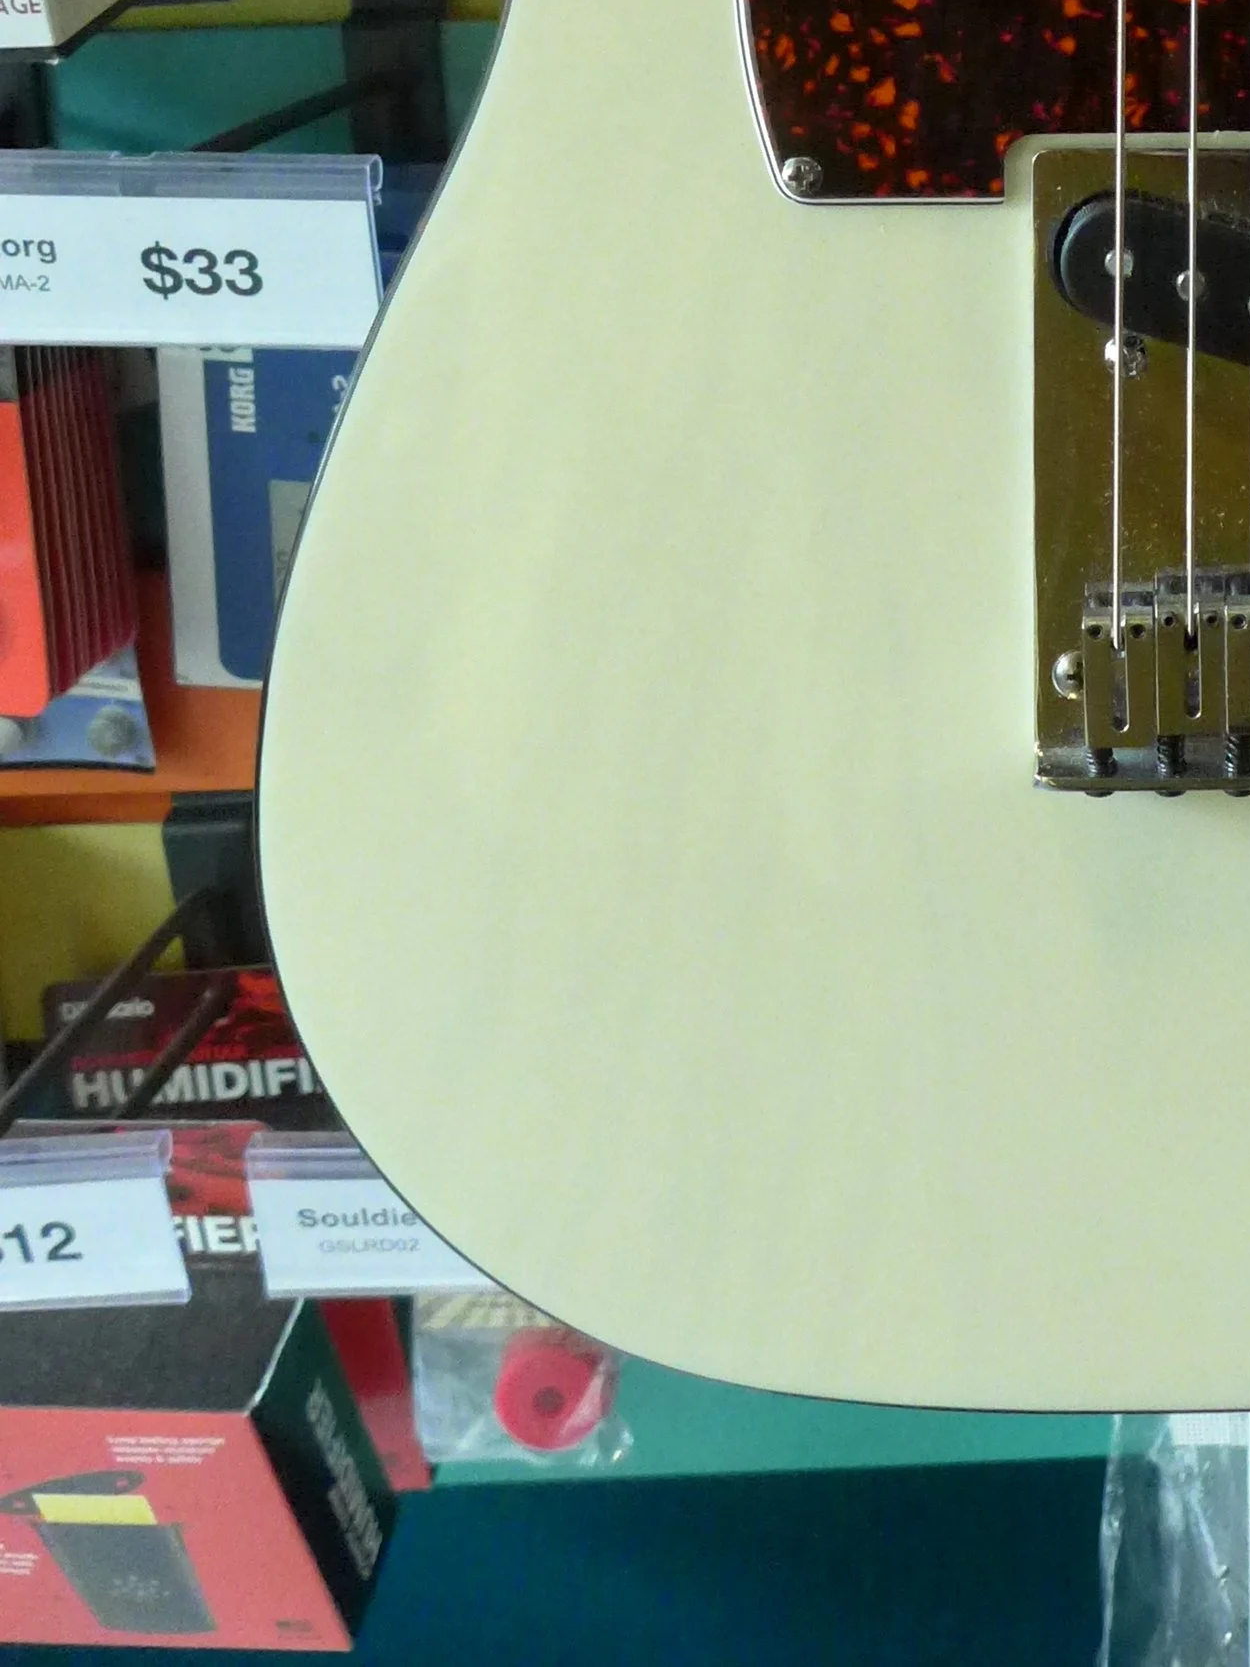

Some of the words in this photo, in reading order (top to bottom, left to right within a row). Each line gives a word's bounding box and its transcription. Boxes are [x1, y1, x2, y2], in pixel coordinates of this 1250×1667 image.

[140, 240, 263, 300] $33
[228, 367, 257, 433] KORG
[72, 1057, 323, 1111] HUMIDIFI
[0, 1221, 83, 1263] 12
